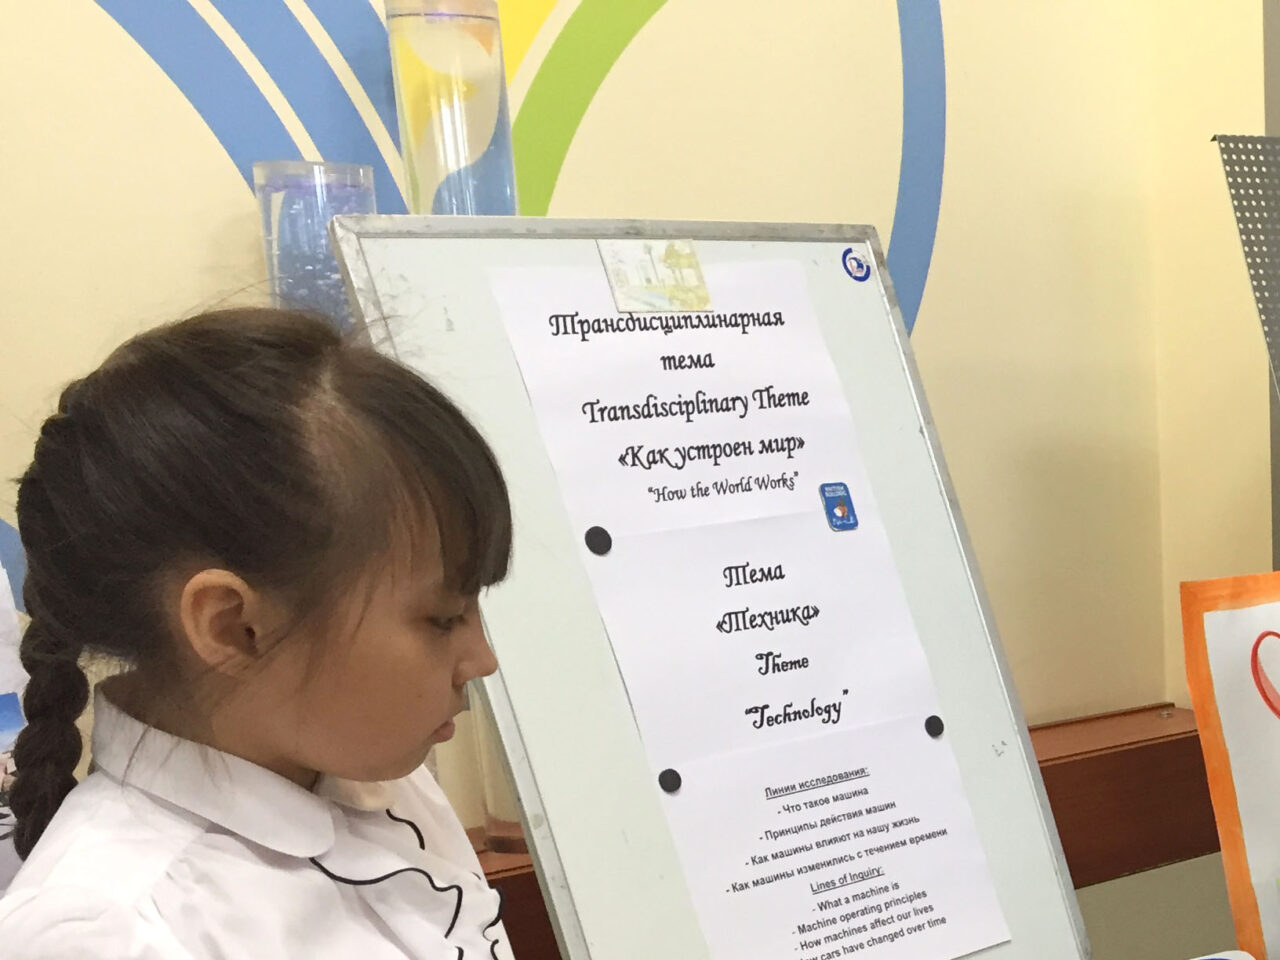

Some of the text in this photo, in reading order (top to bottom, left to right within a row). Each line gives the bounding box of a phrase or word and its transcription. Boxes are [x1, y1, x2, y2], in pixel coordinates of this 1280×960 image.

[549, 311, 785, 341] Трансдисциплинарная
[660, 352, 715, 371] тема
[582, 386, 810, 423] Transdisciplinary Theme
[618, 435, 805, 471] «Как устроен мир»
[691, 482, 710, 499] the
[713, 477, 752, 496] World
[723, 561, 786, 588] Тема
[716, 604, 820, 634] «Техника»
[755, 651, 810, 675] Theme
[765, 783, 796, 799] Линии
[782, 802, 802, 814] Что
[803, 796, 830, 810] такое
[833, 787, 869, 803] машина
[764, 821, 818, 841] Принципы
[820, 808, 864, 828] действия
[865, 800, 896, 816] машин
[751, 852, 770, 866] Как
[771, 843, 814, 861] машины
[815, 833, 851, 849] влияют
[853, 829, 865, 839] на
[866, 823, 890, 837] нашу
[892, 815, 920, 829] жизнь
[732, 879, 751, 894] Как
[752, 869, 795, 888] машины
[796, 853, 856, 876] изменились
[857, 850, 863, 859] с
[864, 839, 907, 857] течением
[909, 828, 948, 845] времени
[810, 878, 836, 893] Lines
[839, 873, 848, 886] of
[817, 898, 842, 913] What
[844, 896, 851, 904] a
[852, 886, 890, 903] machine
[892, 881, 900, 891] is
[797, 917, 838, 935] Machine
[839, 904, 882, 925] operating
[884, 889, 928, 912] principles
[800, 938, 822, 952] How
[824, 923, 868, 943] machines
[869, 914, 896, 931] affect
[896, 910, 912, 922] our
[913, 903, 934, 917] lives
[843, 940, 865, 956] have
[866, 929, 905, 948] changed
[907, 923, 926, 936] over
[927, 915, 947, 930] time
